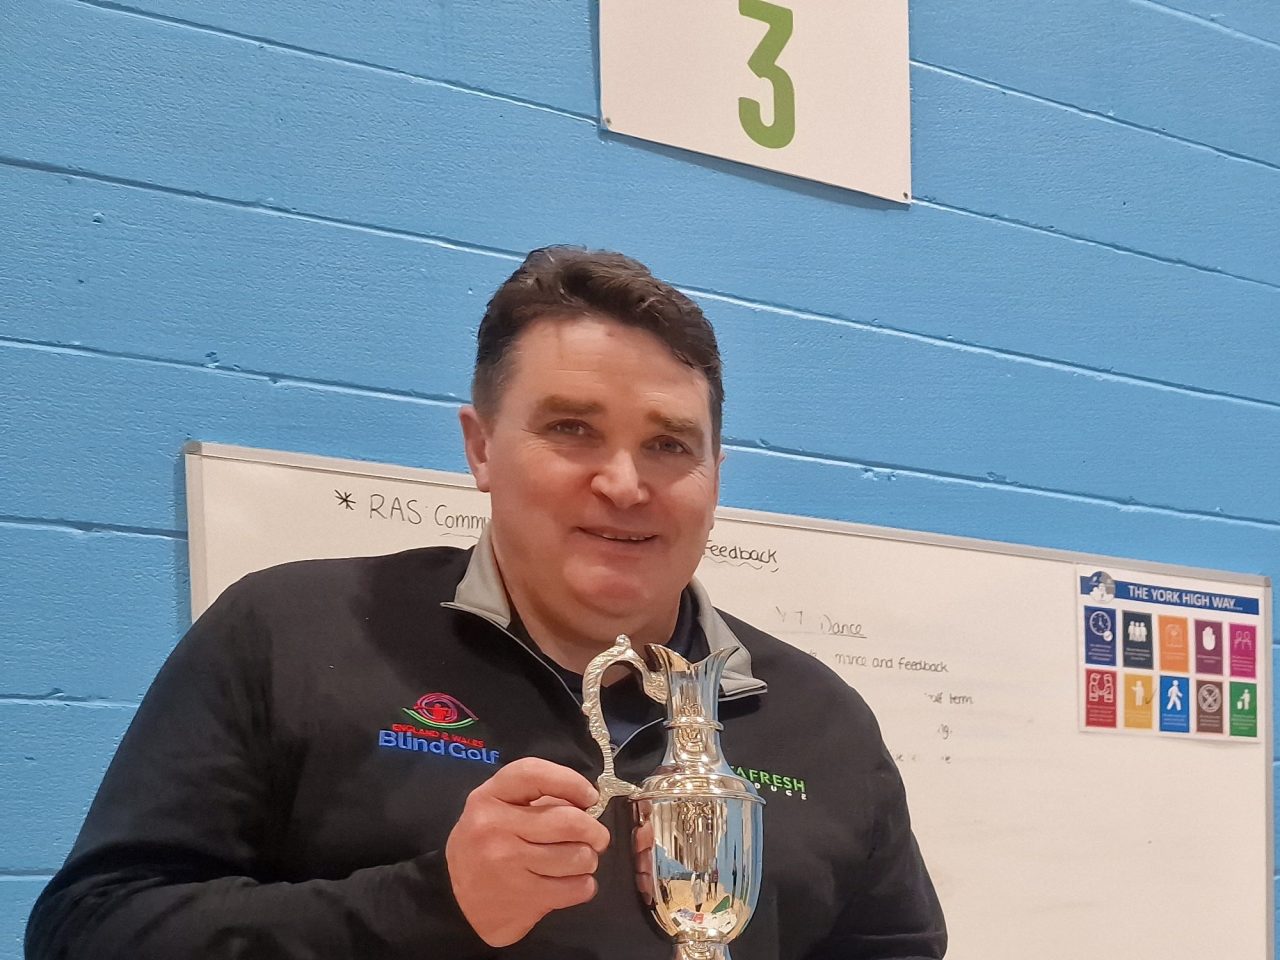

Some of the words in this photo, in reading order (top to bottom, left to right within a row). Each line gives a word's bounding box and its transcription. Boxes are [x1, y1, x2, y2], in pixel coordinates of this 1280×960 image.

[739, 0, 795, 148] 3
[1128, 586, 1148, 599] THE
[1151, 589, 1180, 604] YORK
[1182, 593, 1210, 606] HIGH
[379, 729, 445, 756] Blind
[449, 742, 500, 764] Golf
[392, 723, 439, 738] ENGLAND
[450, 734, 486, 749] WALES
[730, 766, 806, 792] AFRESH
